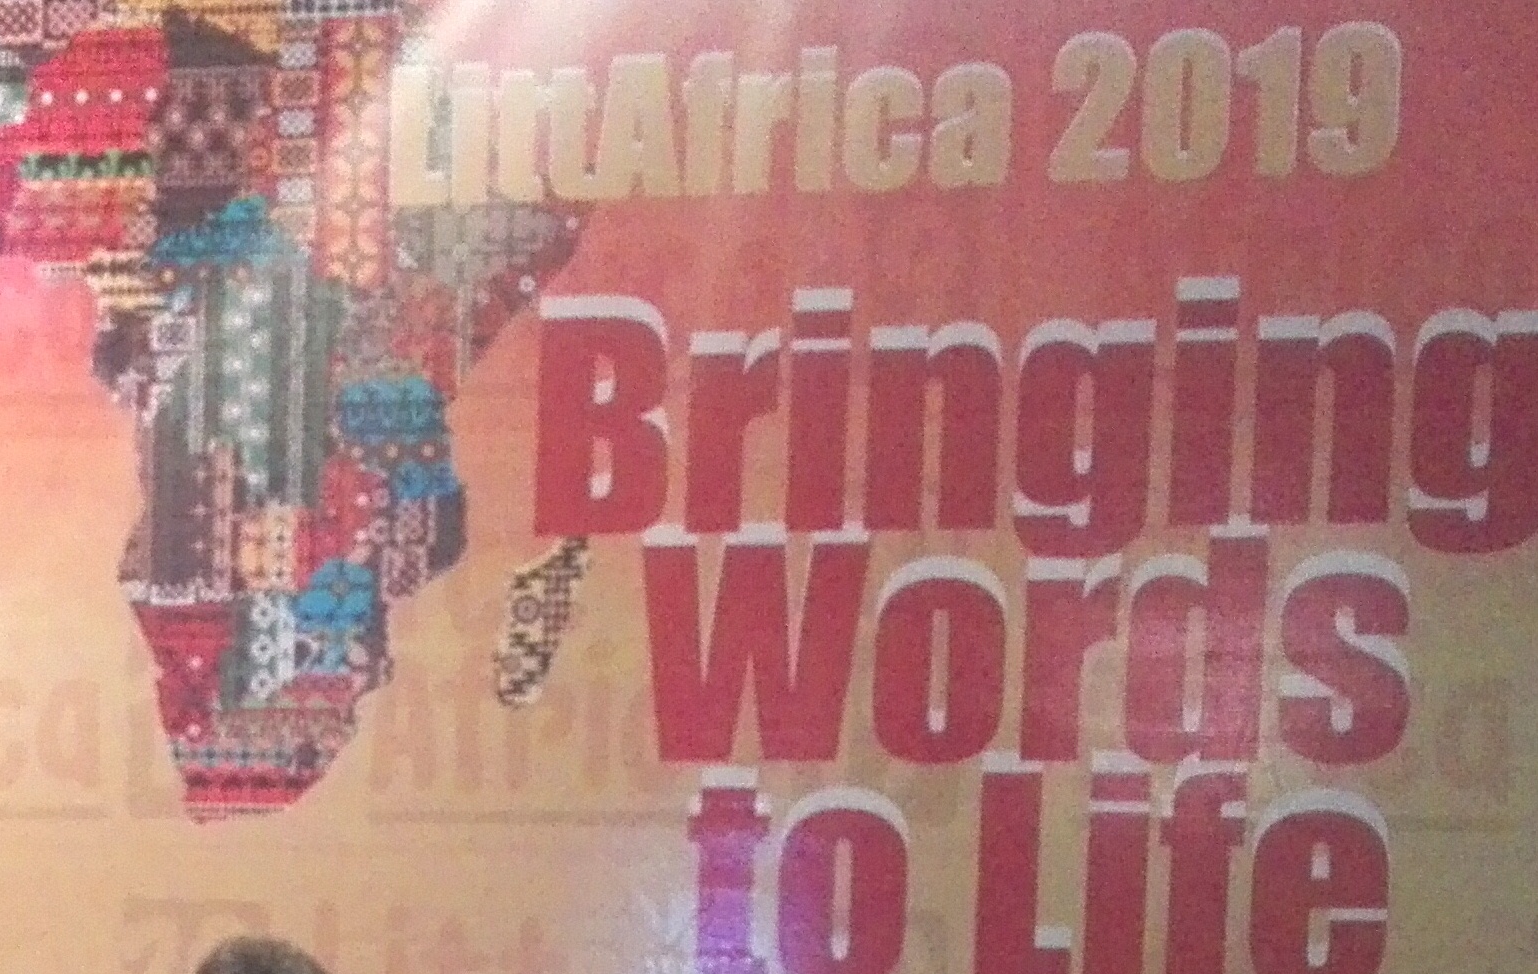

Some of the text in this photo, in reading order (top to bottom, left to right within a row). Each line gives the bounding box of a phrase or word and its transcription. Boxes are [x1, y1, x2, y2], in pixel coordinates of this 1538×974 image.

[390, 20, 1405, 206] LittAfrica 2019
[534, 276, 1538, 559] Bringing
[642, 522, 1412, 766] Words
